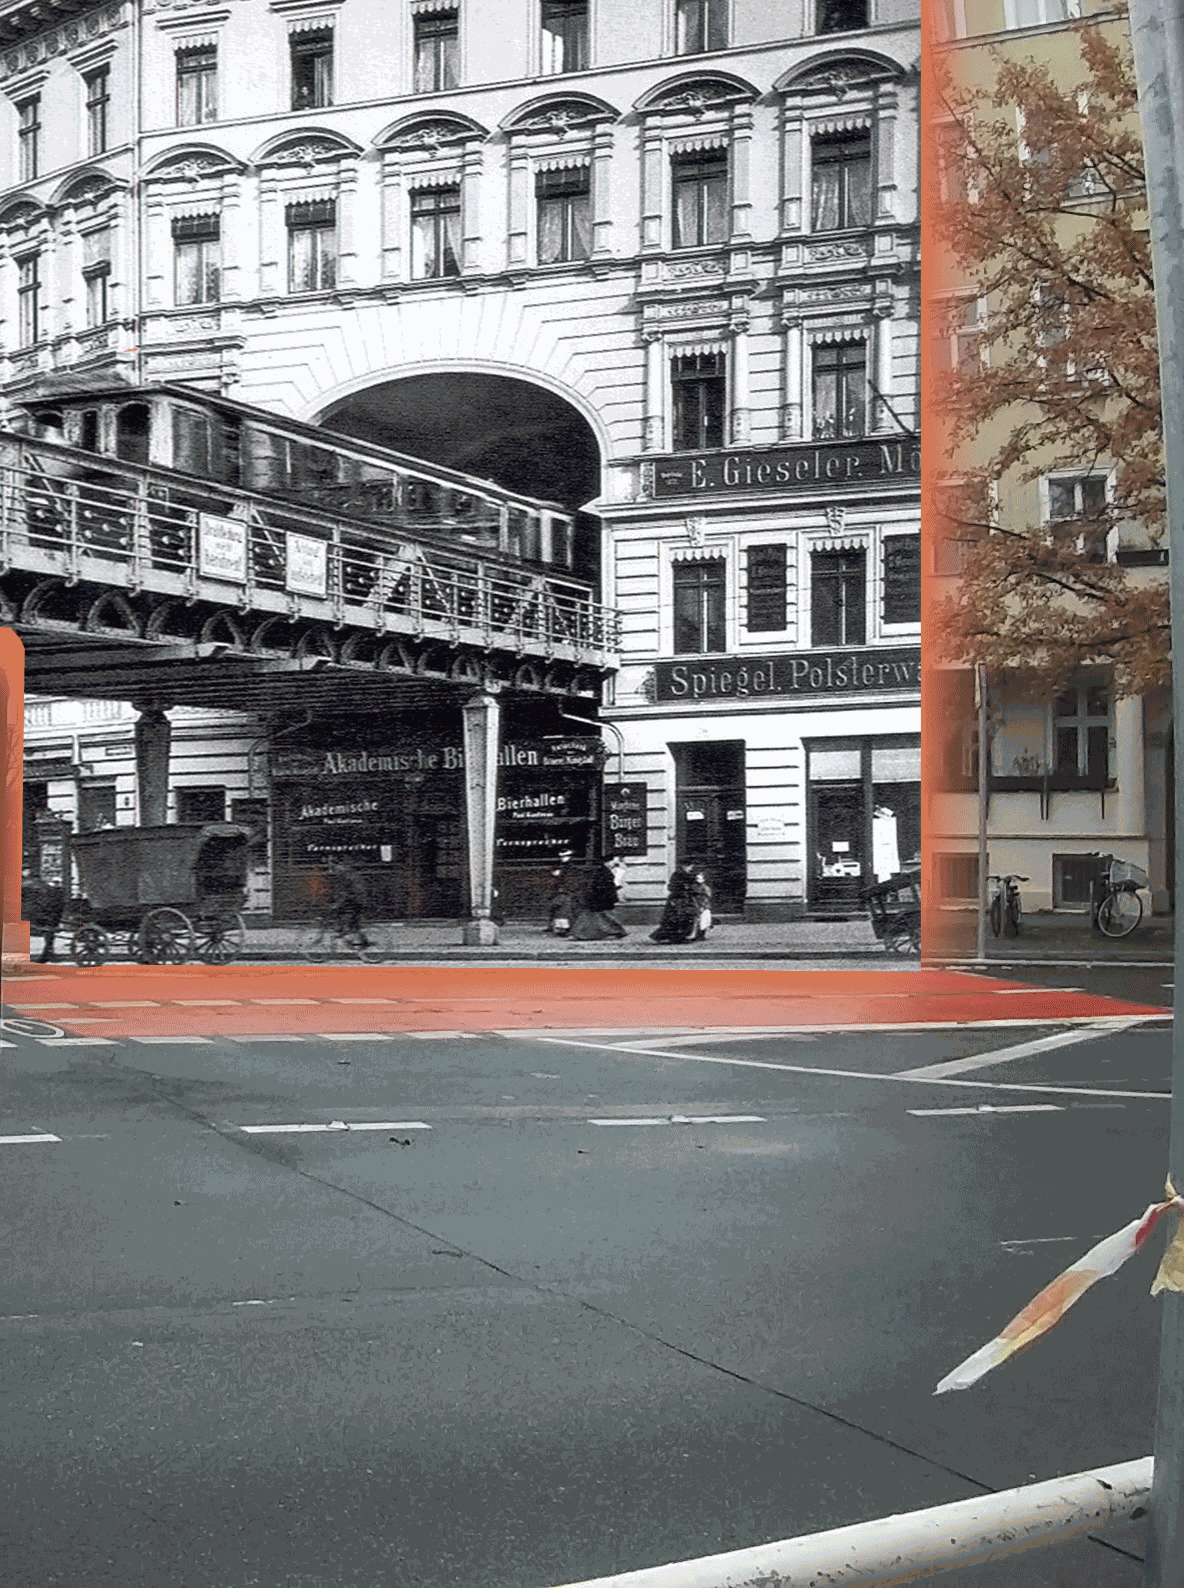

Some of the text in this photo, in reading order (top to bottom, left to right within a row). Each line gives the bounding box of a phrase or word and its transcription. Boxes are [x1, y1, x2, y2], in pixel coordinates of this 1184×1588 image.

[690, 459, 715, 488] E.
[670, 662, 782, 698] Spiegel.
[496, 794, 566, 811] Bierhallen
